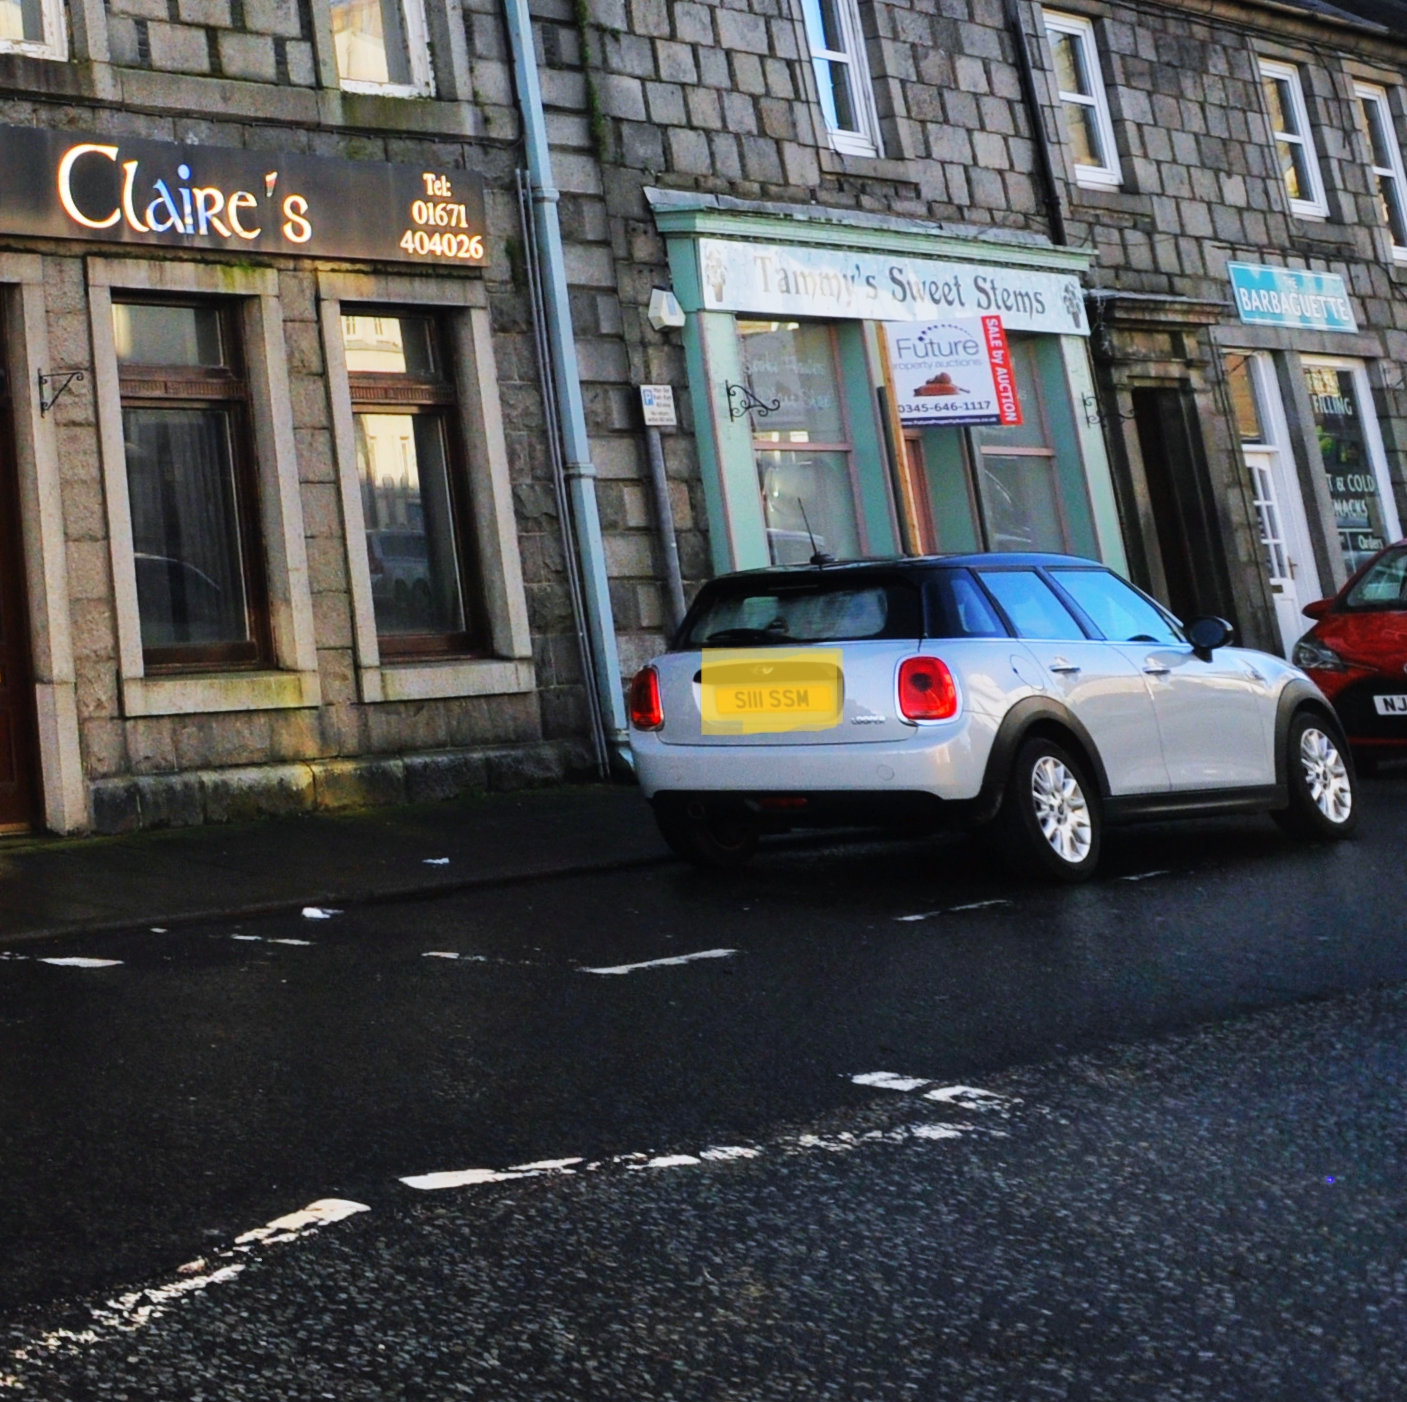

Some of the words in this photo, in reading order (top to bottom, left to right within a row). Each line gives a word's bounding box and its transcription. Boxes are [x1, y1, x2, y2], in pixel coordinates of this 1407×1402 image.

[422, 173, 452, 197] Tel:
[412, 200, 469, 228] 01671
[400, 230, 484, 259] 404026
[754, 254, 878, 308] Tammy's
[888, 265, 966, 308] Sweet
[973, 275, 1046, 320] Stems
[1239, 288, 1350, 321] BARBAGUETTE
[986, 318, 1003, 347] SALE
[896, 337, 980, 359] Future
[992, 350, 1004, 364] by
[894, 360, 933, 371] roperty
[935, 358, 983, 369] auctions
[995, 367, 1018, 421] AUCTION
[1347, 473, 1376, 493] COLD
[1334, 498, 1369, 517] NACKS
[768, 689, 810, 709] SSM
